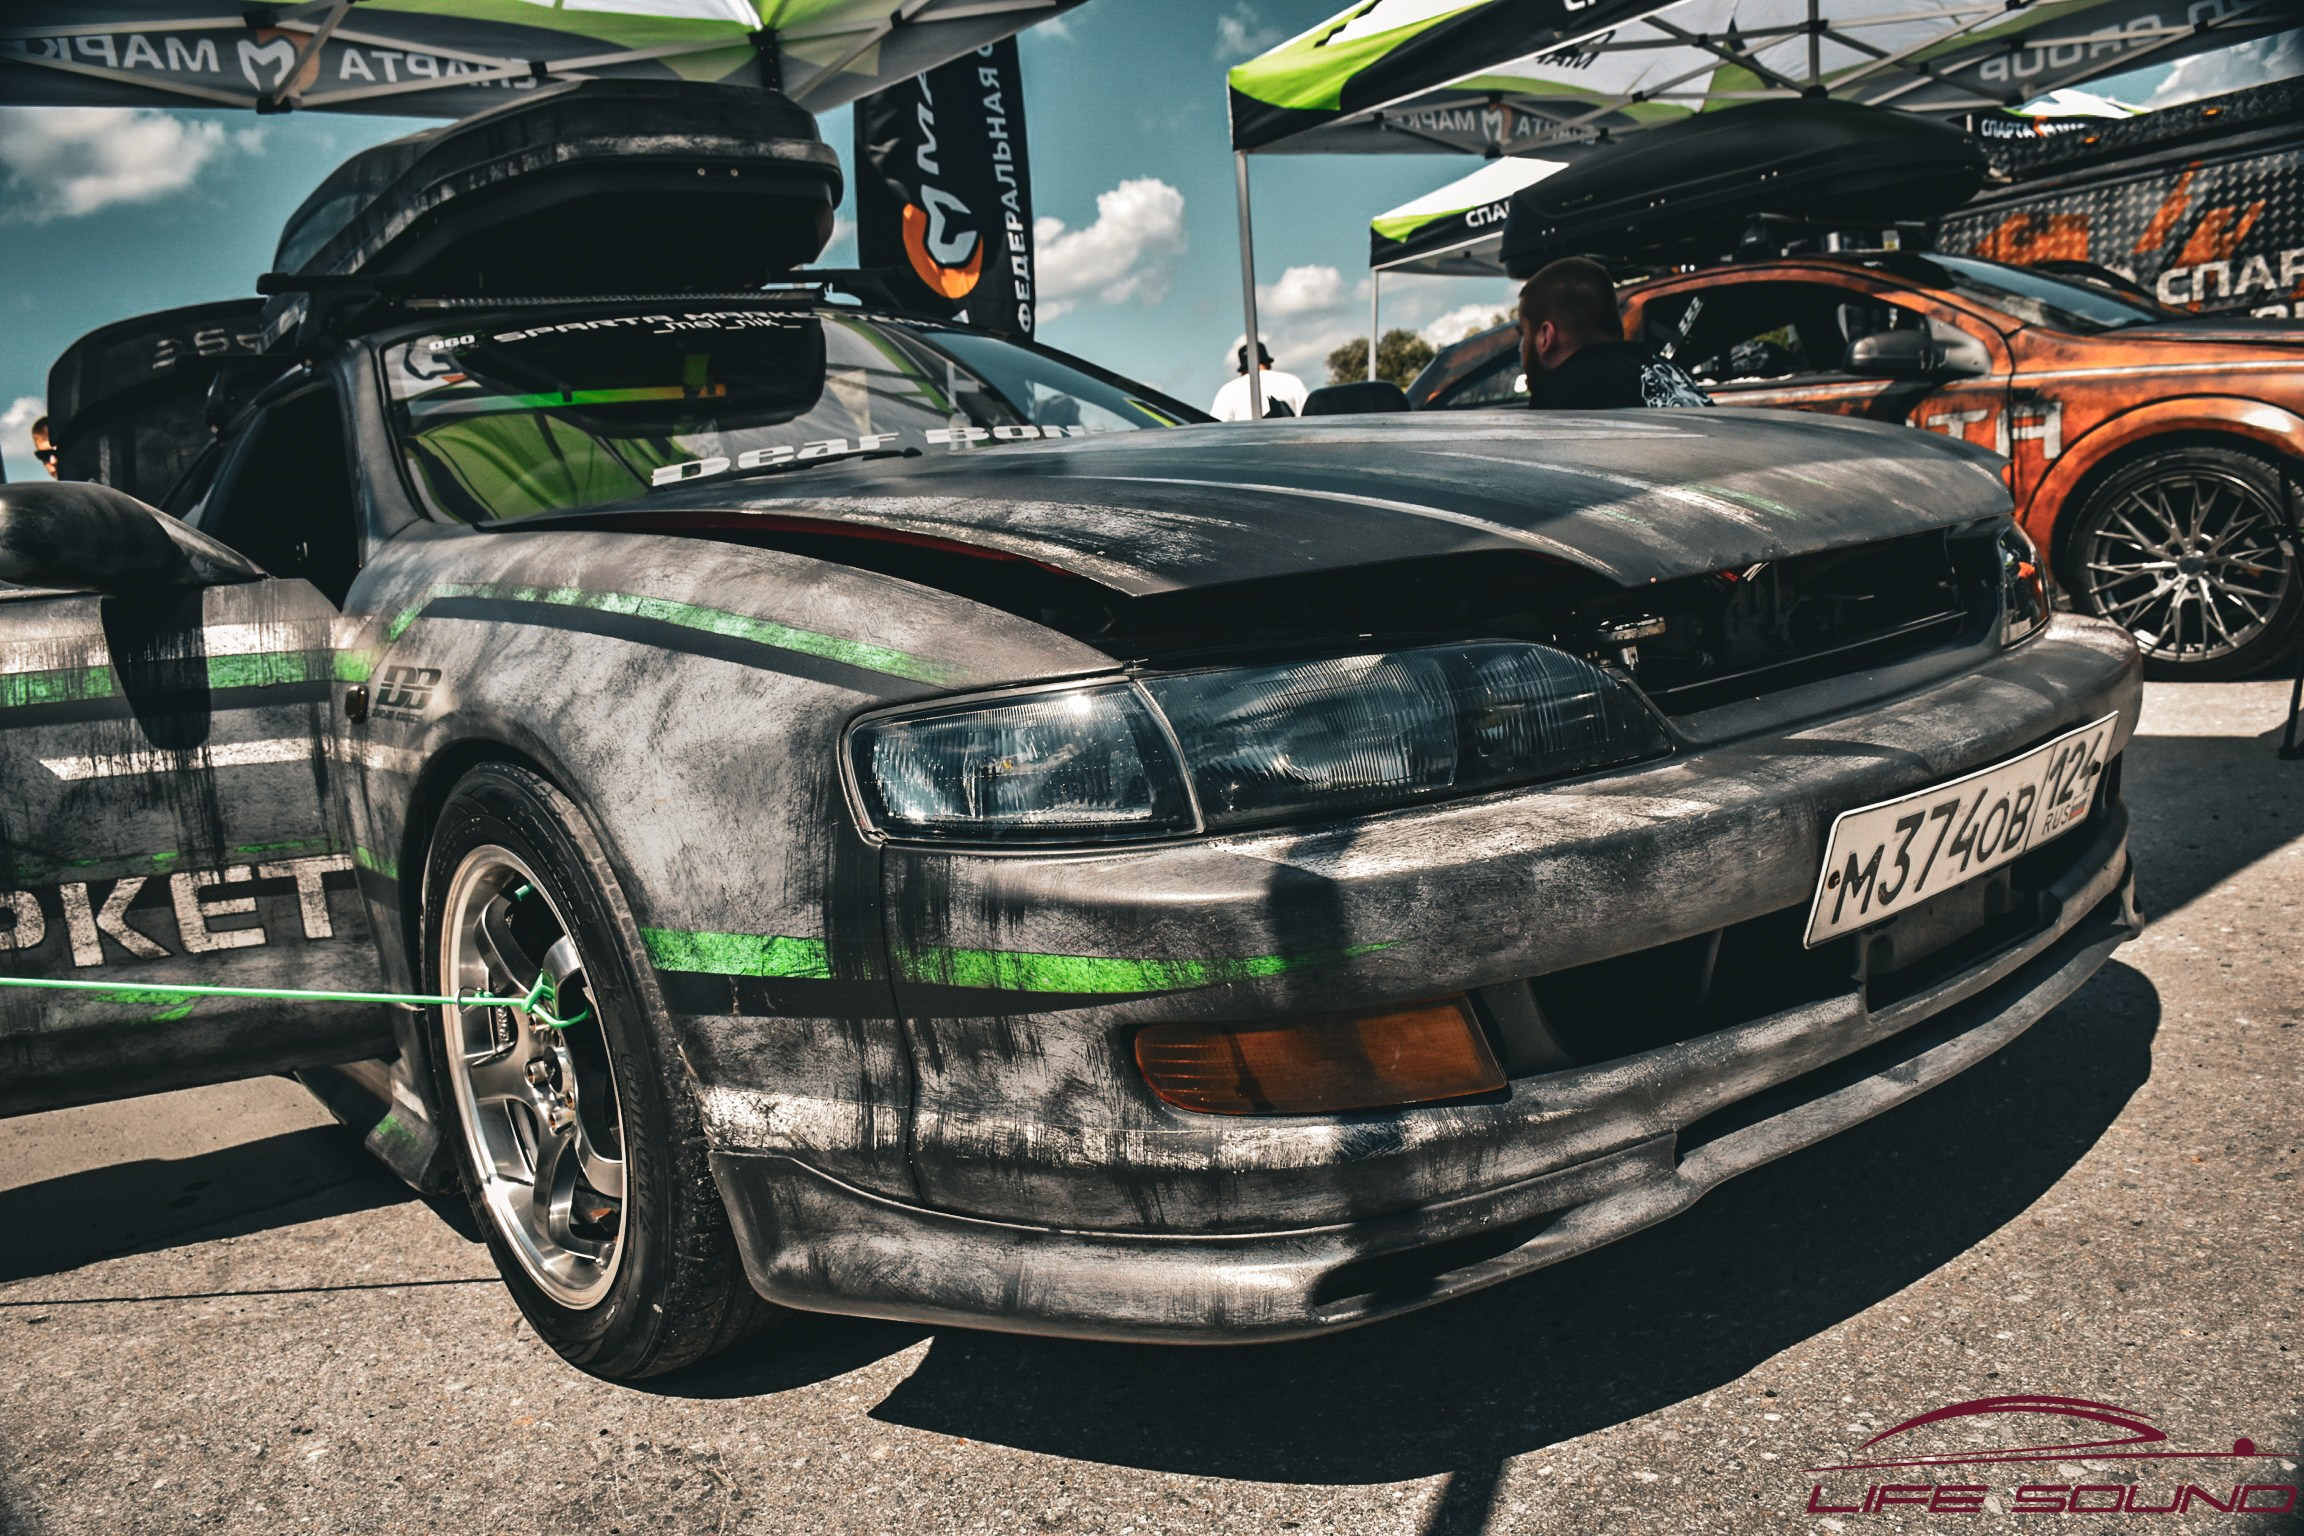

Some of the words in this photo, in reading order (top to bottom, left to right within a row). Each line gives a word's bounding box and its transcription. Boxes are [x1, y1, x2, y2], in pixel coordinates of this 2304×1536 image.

[978, 67, 1032, 333] ФЕДЕРАЛЬНАЯ
[493, 314, 675, 343] SPARTA
[2042, 804, 2071, 836] RUS
